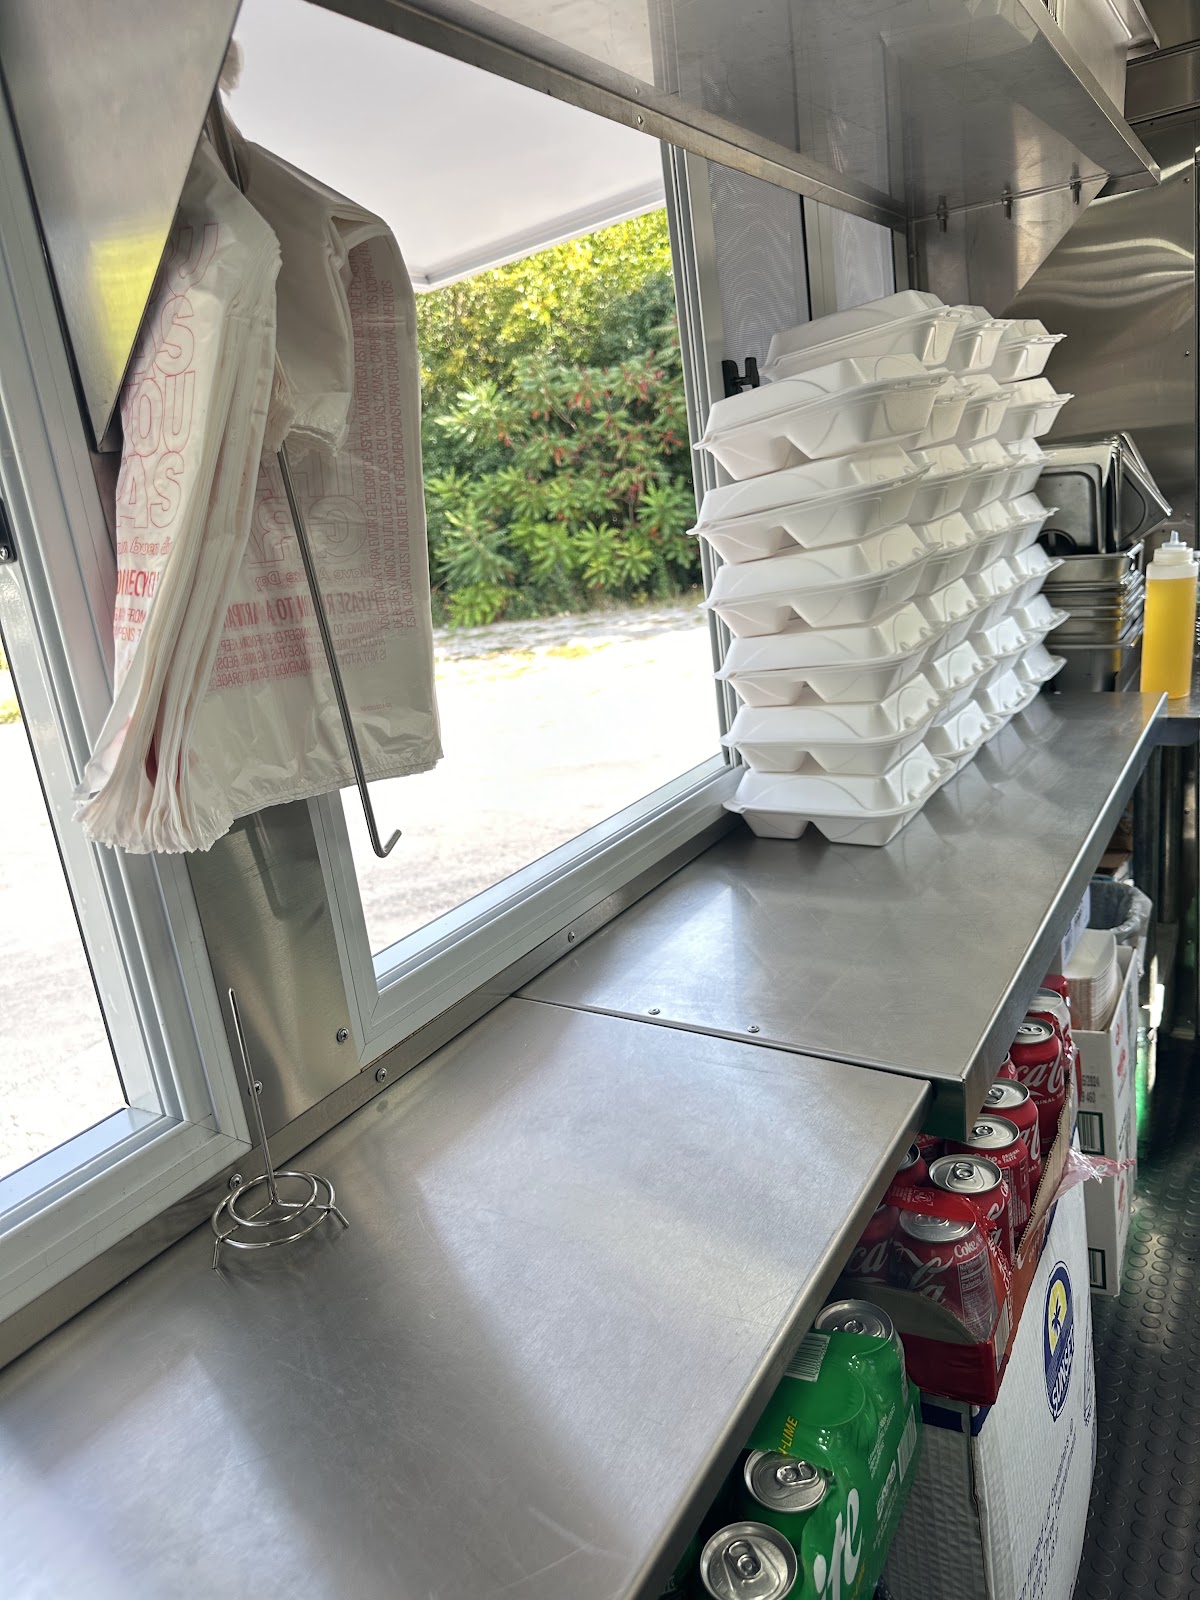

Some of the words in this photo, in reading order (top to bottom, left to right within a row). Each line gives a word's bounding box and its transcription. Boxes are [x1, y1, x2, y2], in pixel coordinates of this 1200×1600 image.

[350, 292, 362, 305] DE
[366, 295, 379, 315] LOS
[381, 280, 395, 336] ALIMENTOS
[351, 308, 364, 338] BOLSA
[354, 340, 367, 362] ESTA
[369, 326, 382, 363] CARROS
[386, 337, 399, 382] GUARDAR
[355, 364, 370, 416] MANTENGA
[389, 383, 400, 407] PARA
[377, 439, 388, 451] EN
[390, 408, 405, 482] RECOMENDADAS
[362, 455, 374, 466] DE
[378, 452, 390, 481] BOLSA
[363, 470, 376, 504] PELIGRO
[380, 482, 391, 504] ESTA
[394, 483, 406, 497] NO
[367, 506, 377, 517] EL
[381, 505, 394, 537] UTILICE
[368, 519, 380, 547] EVITAR
[130, 537, 158, 556] buen
[384, 539, 395, 551] NO
[399, 538, 409, 551] UN
[370, 548, 381, 570] PARA
[399, 553, 410, 564] ES
[400, 565, 411, 578] NO
[401, 579, 414, 606] BOLSA
[393, 617, 403, 629] DE
[404, 606, 416, 628] ESTA
[953, 1240, 977, 1259] Coke
[1051, 1325, 1074, 1418] SUNSET
